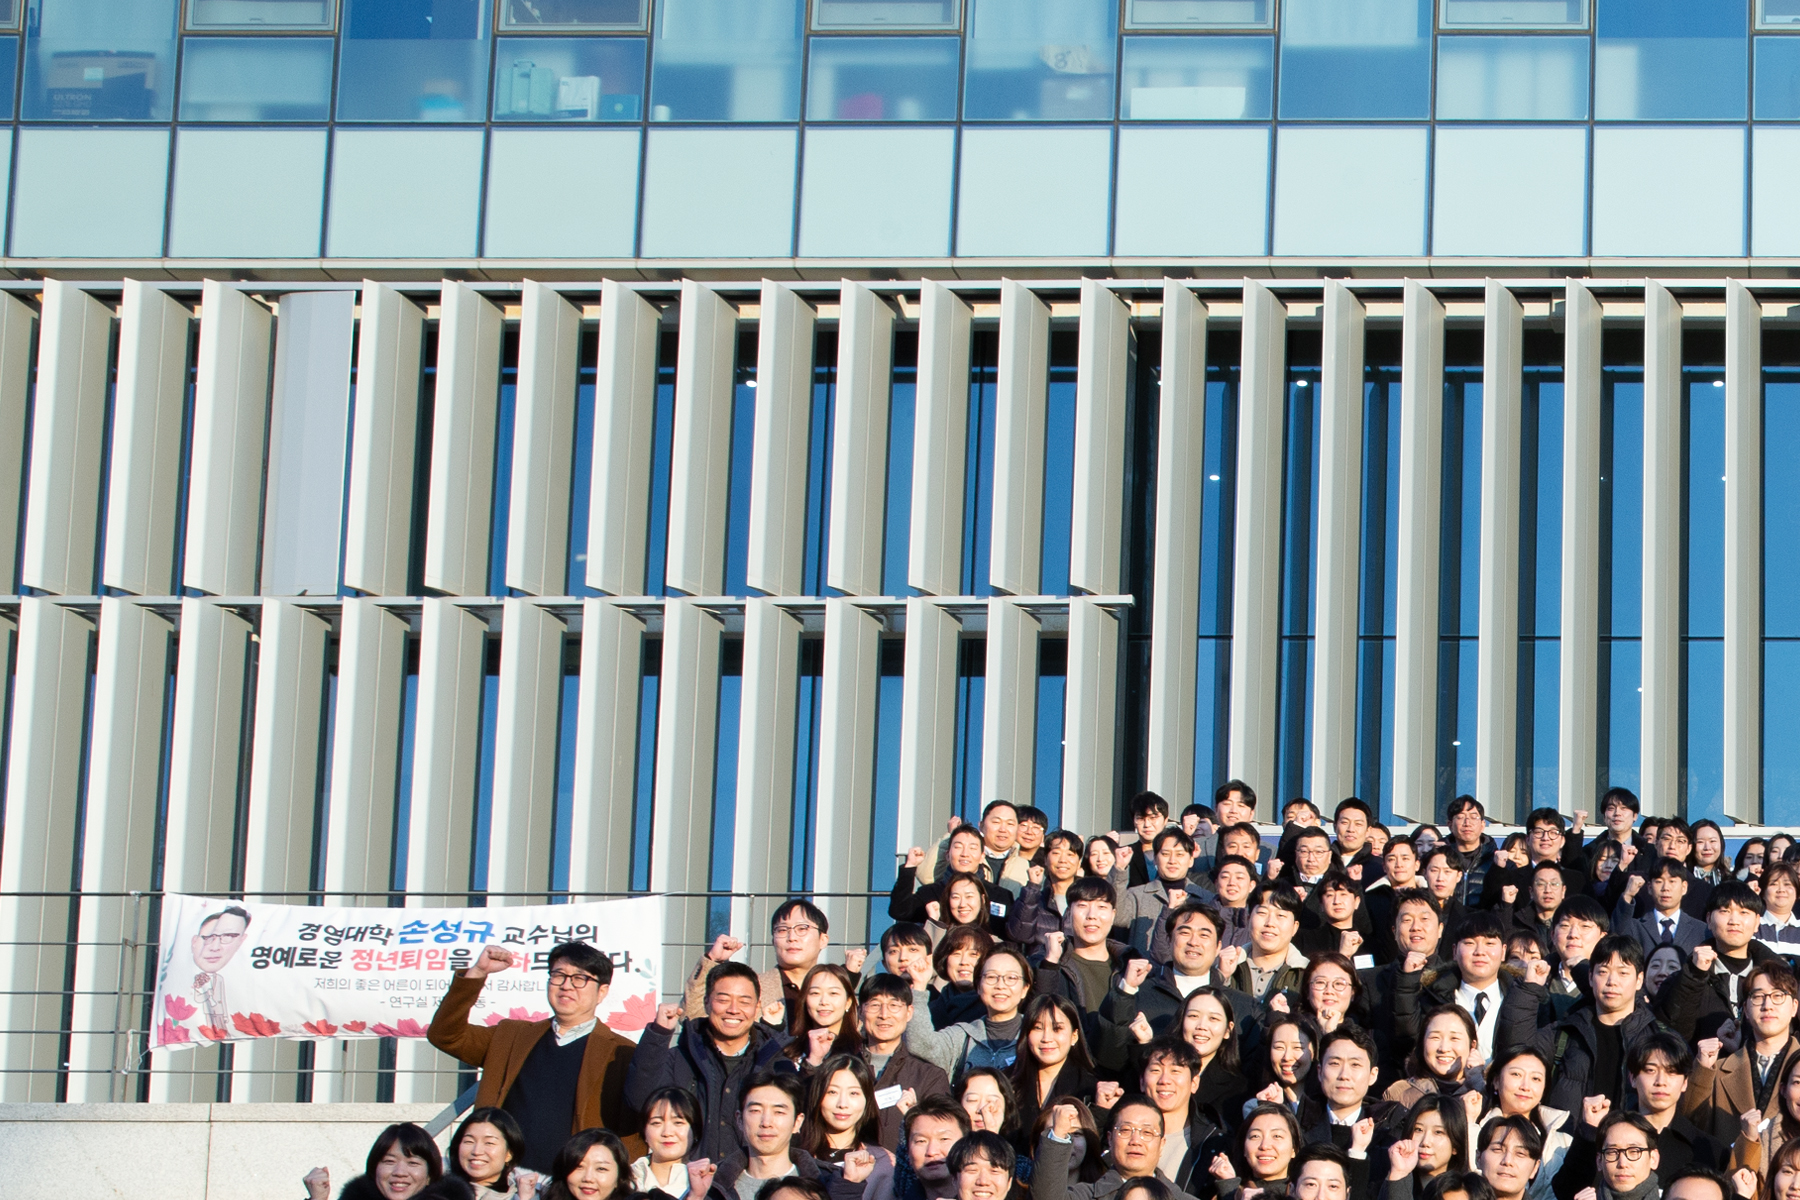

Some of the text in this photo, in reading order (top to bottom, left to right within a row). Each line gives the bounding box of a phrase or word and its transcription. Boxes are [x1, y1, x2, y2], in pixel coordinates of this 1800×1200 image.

[298, 919, 599, 946] 경영대학 손성규 교수님의
[250, 946, 342, 969] 명예로운
[350, 947, 473, 972] 정년퇴임을
[314, 977, 351, 990] 저희의
[355, 978, 380, 991] 좋은
[383, 979, 422, 991] 어른이
[389, 996, 428, 1008] 연구실
